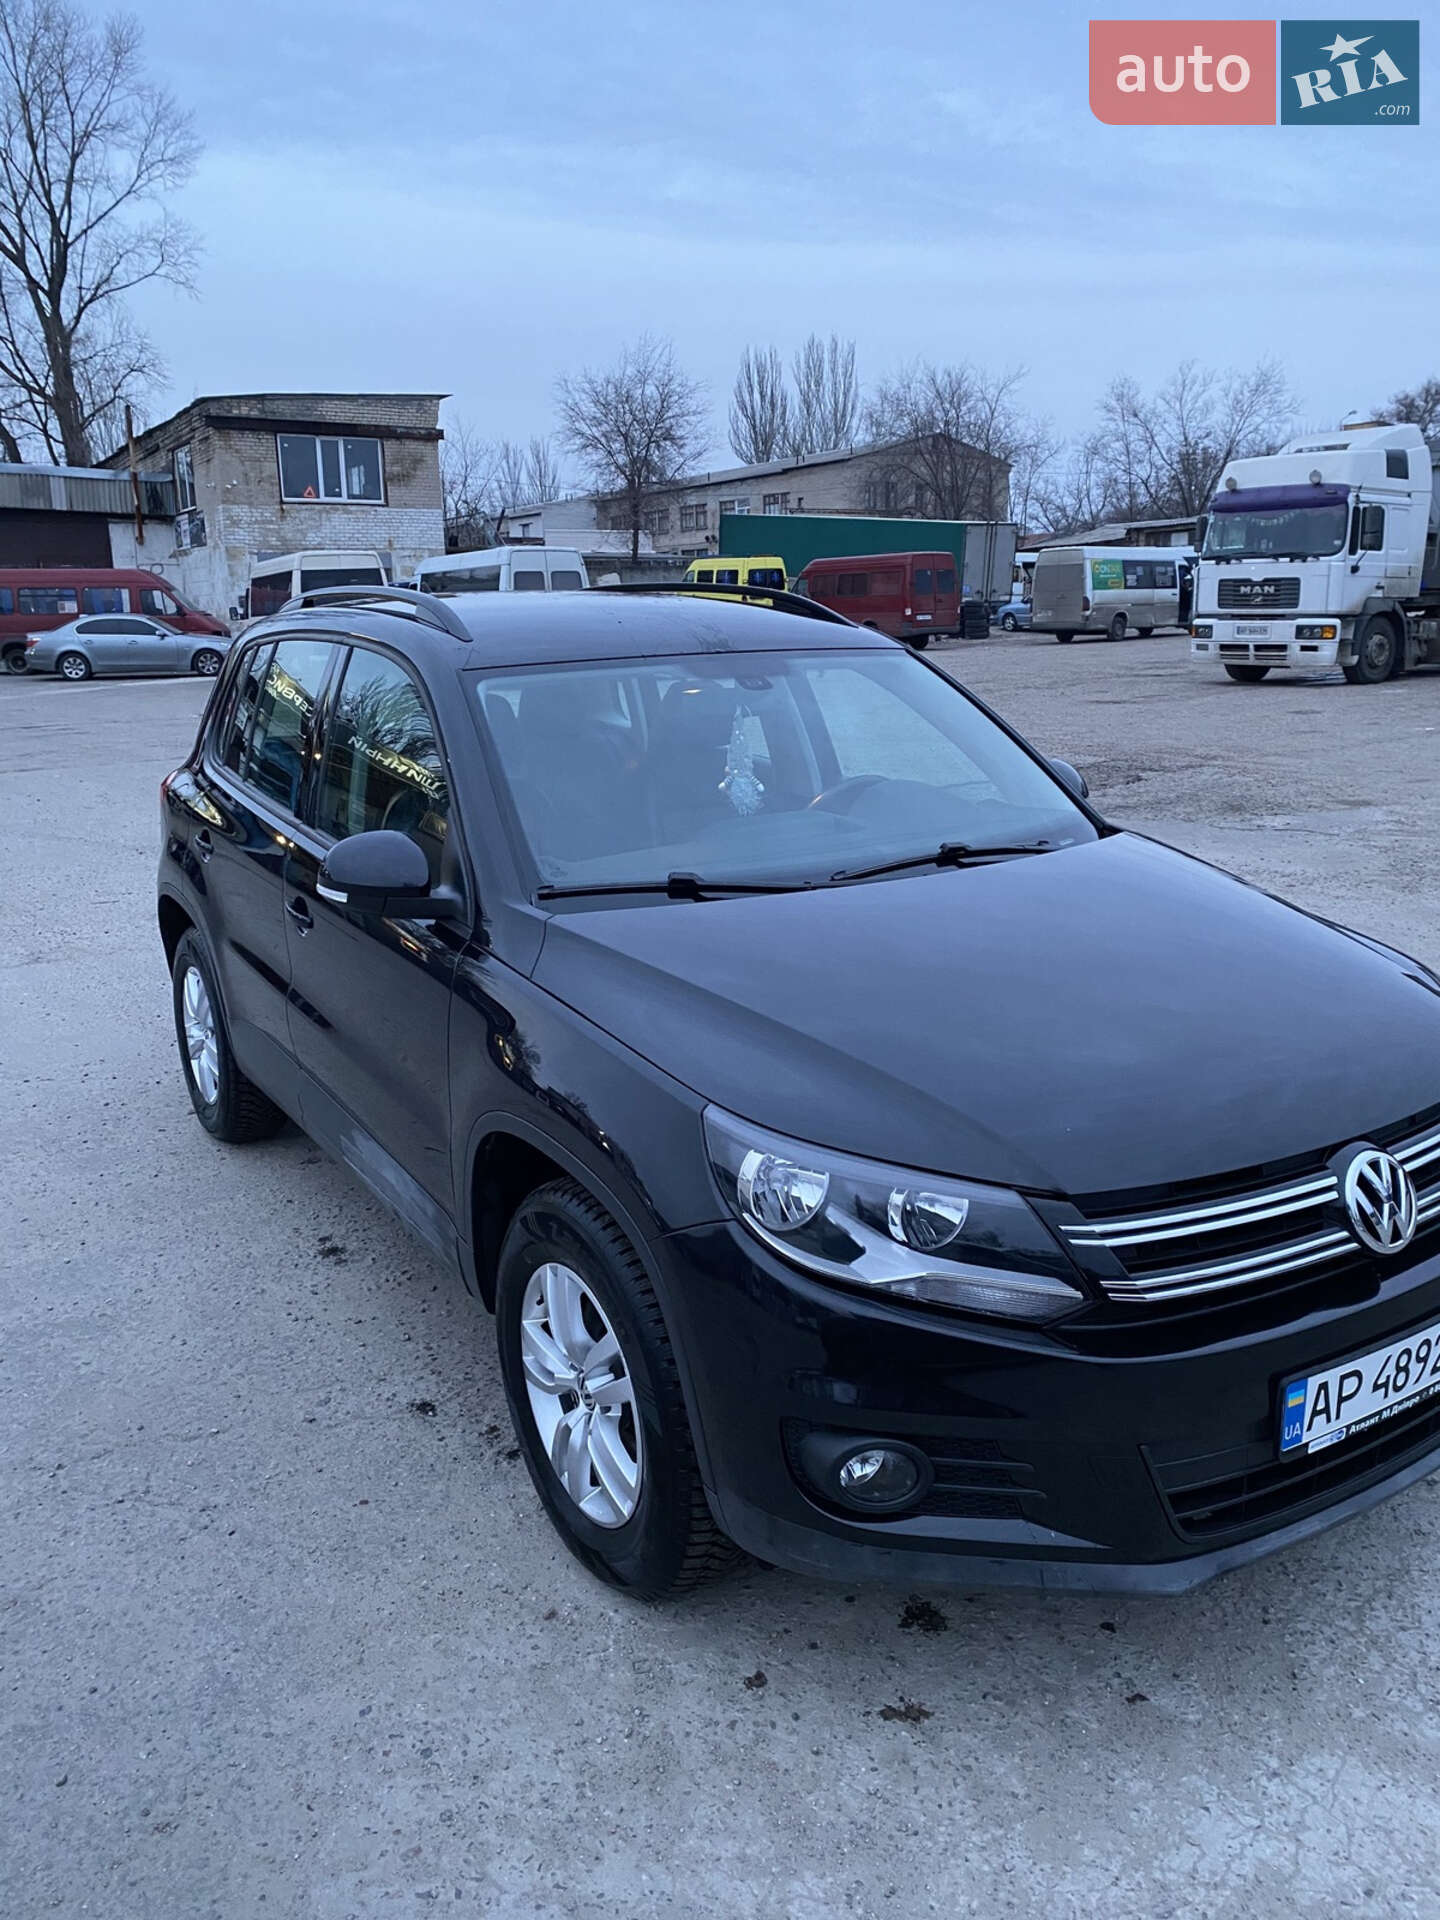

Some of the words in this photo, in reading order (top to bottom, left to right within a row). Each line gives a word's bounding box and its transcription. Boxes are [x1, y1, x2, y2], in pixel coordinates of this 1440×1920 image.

[1240, 585, 1275, 594] MAN
[1306, 1369, 1363, 1432] AP
[1284, 1422, 1301, 1440] UA
